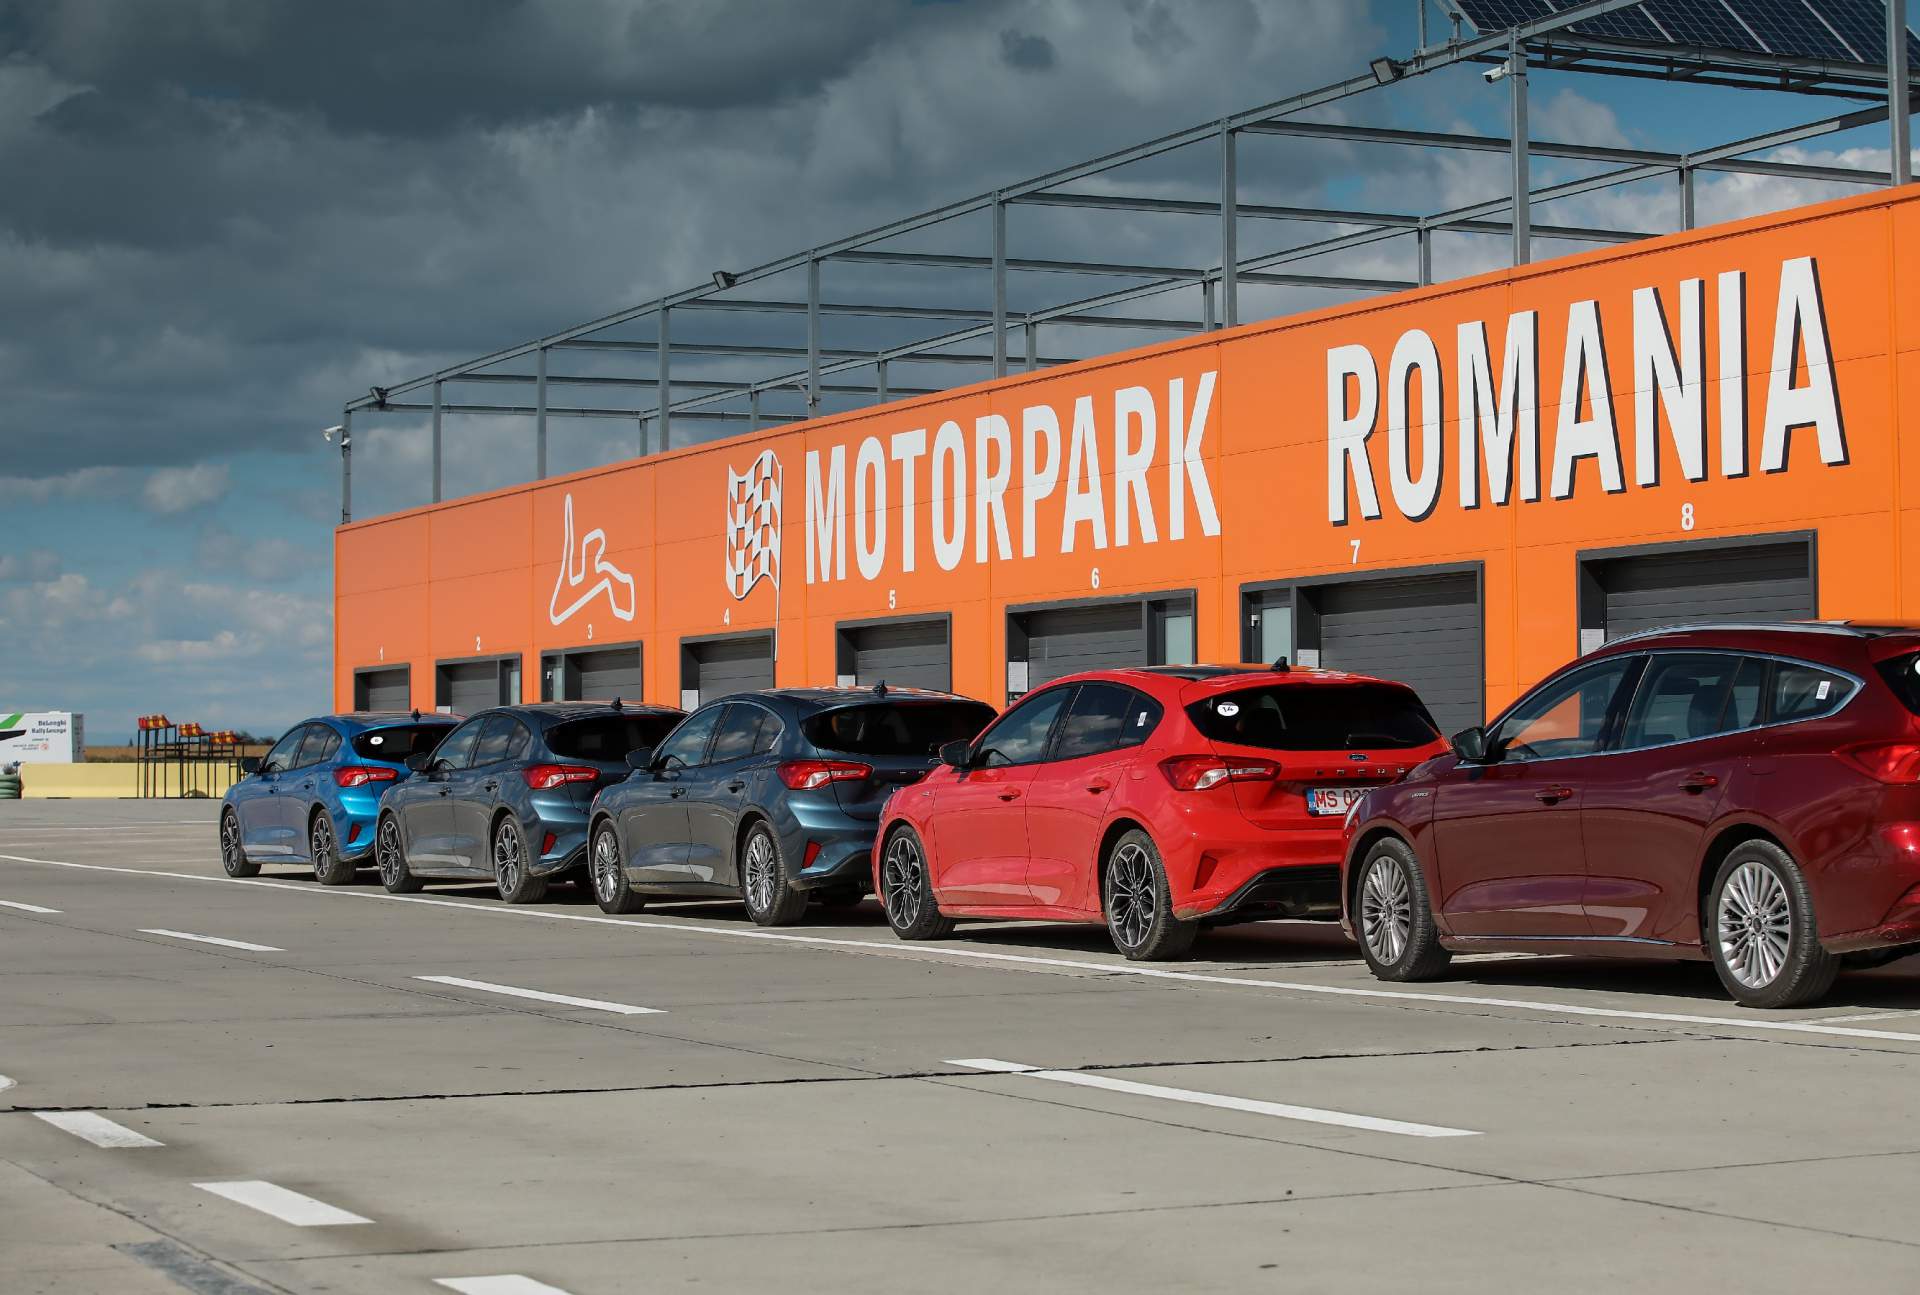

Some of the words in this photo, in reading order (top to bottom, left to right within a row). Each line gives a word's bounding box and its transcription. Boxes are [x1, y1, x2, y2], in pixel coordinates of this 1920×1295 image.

[805, 370, 1222, 585] MOTORPARK
[1327, 257, 1846, 526] ROMANIA
[1681, 503, 1695, 530] 8
[1350, 540, 1361, 564] 7
[1091, 568, 1100, 589] 6
[888, 590, 897, 609] 5
[723, 608, 731, 625] 4
[587, 623, 593, 640] 3
[475, 635, 481, 651] 2
[379, 646, 384, 660] 1
[1315, 790, 1338, 808] MS
